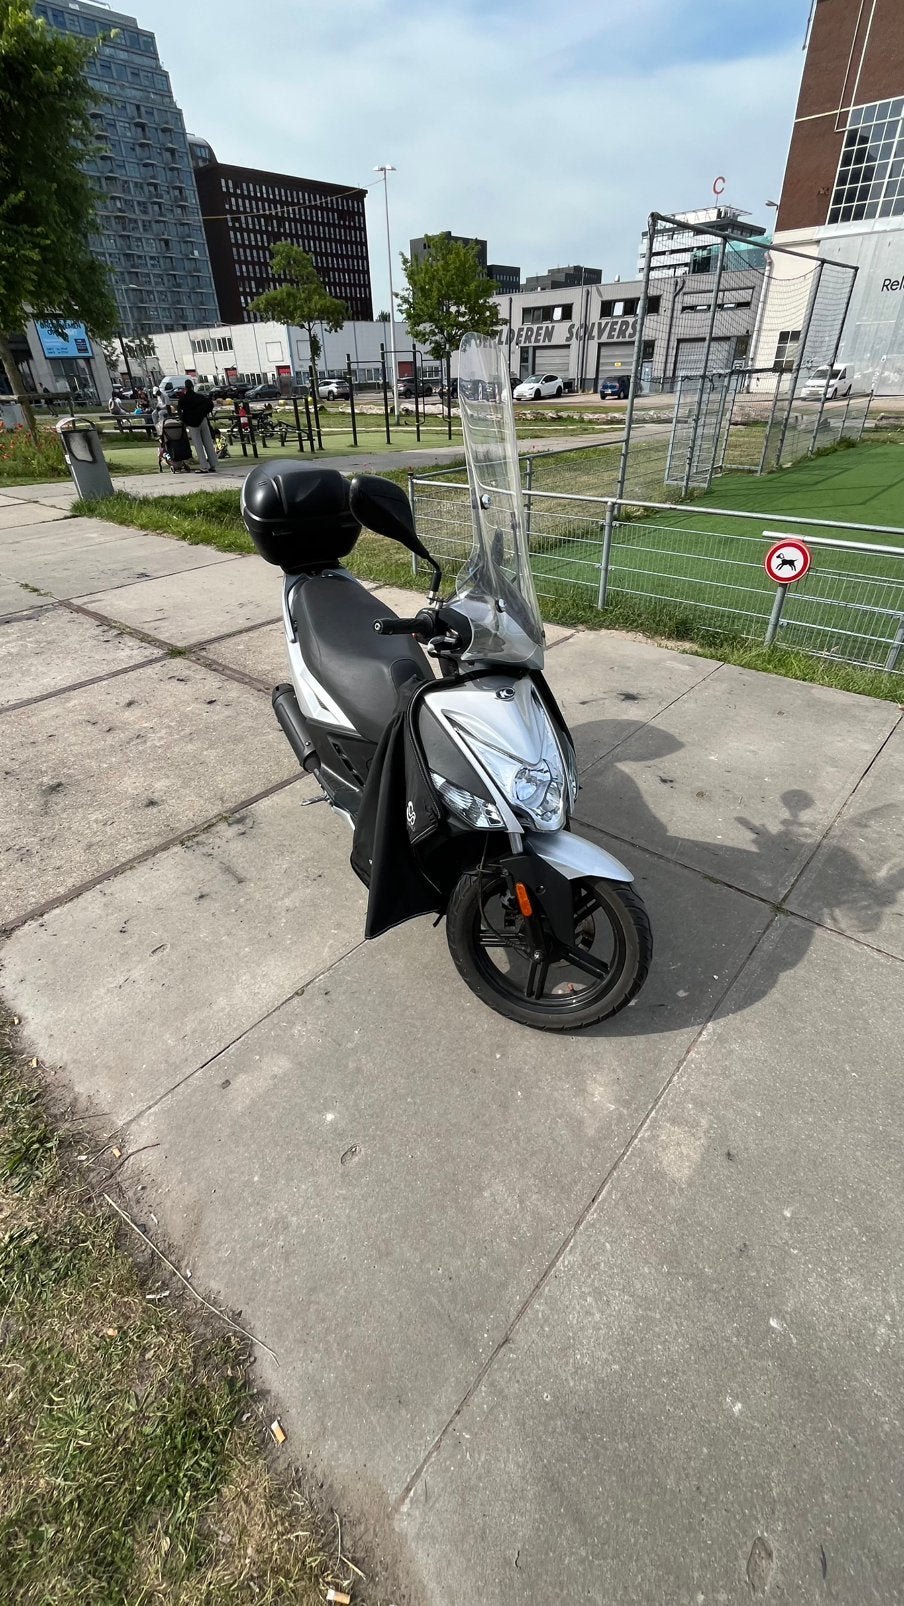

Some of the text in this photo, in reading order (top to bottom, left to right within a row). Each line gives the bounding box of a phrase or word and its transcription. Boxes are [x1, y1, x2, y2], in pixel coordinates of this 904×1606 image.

[713, 176, 725, 195] C
[881, 275, 904, 292] Rel
[565, 318, 638, 343] SOLVERS
